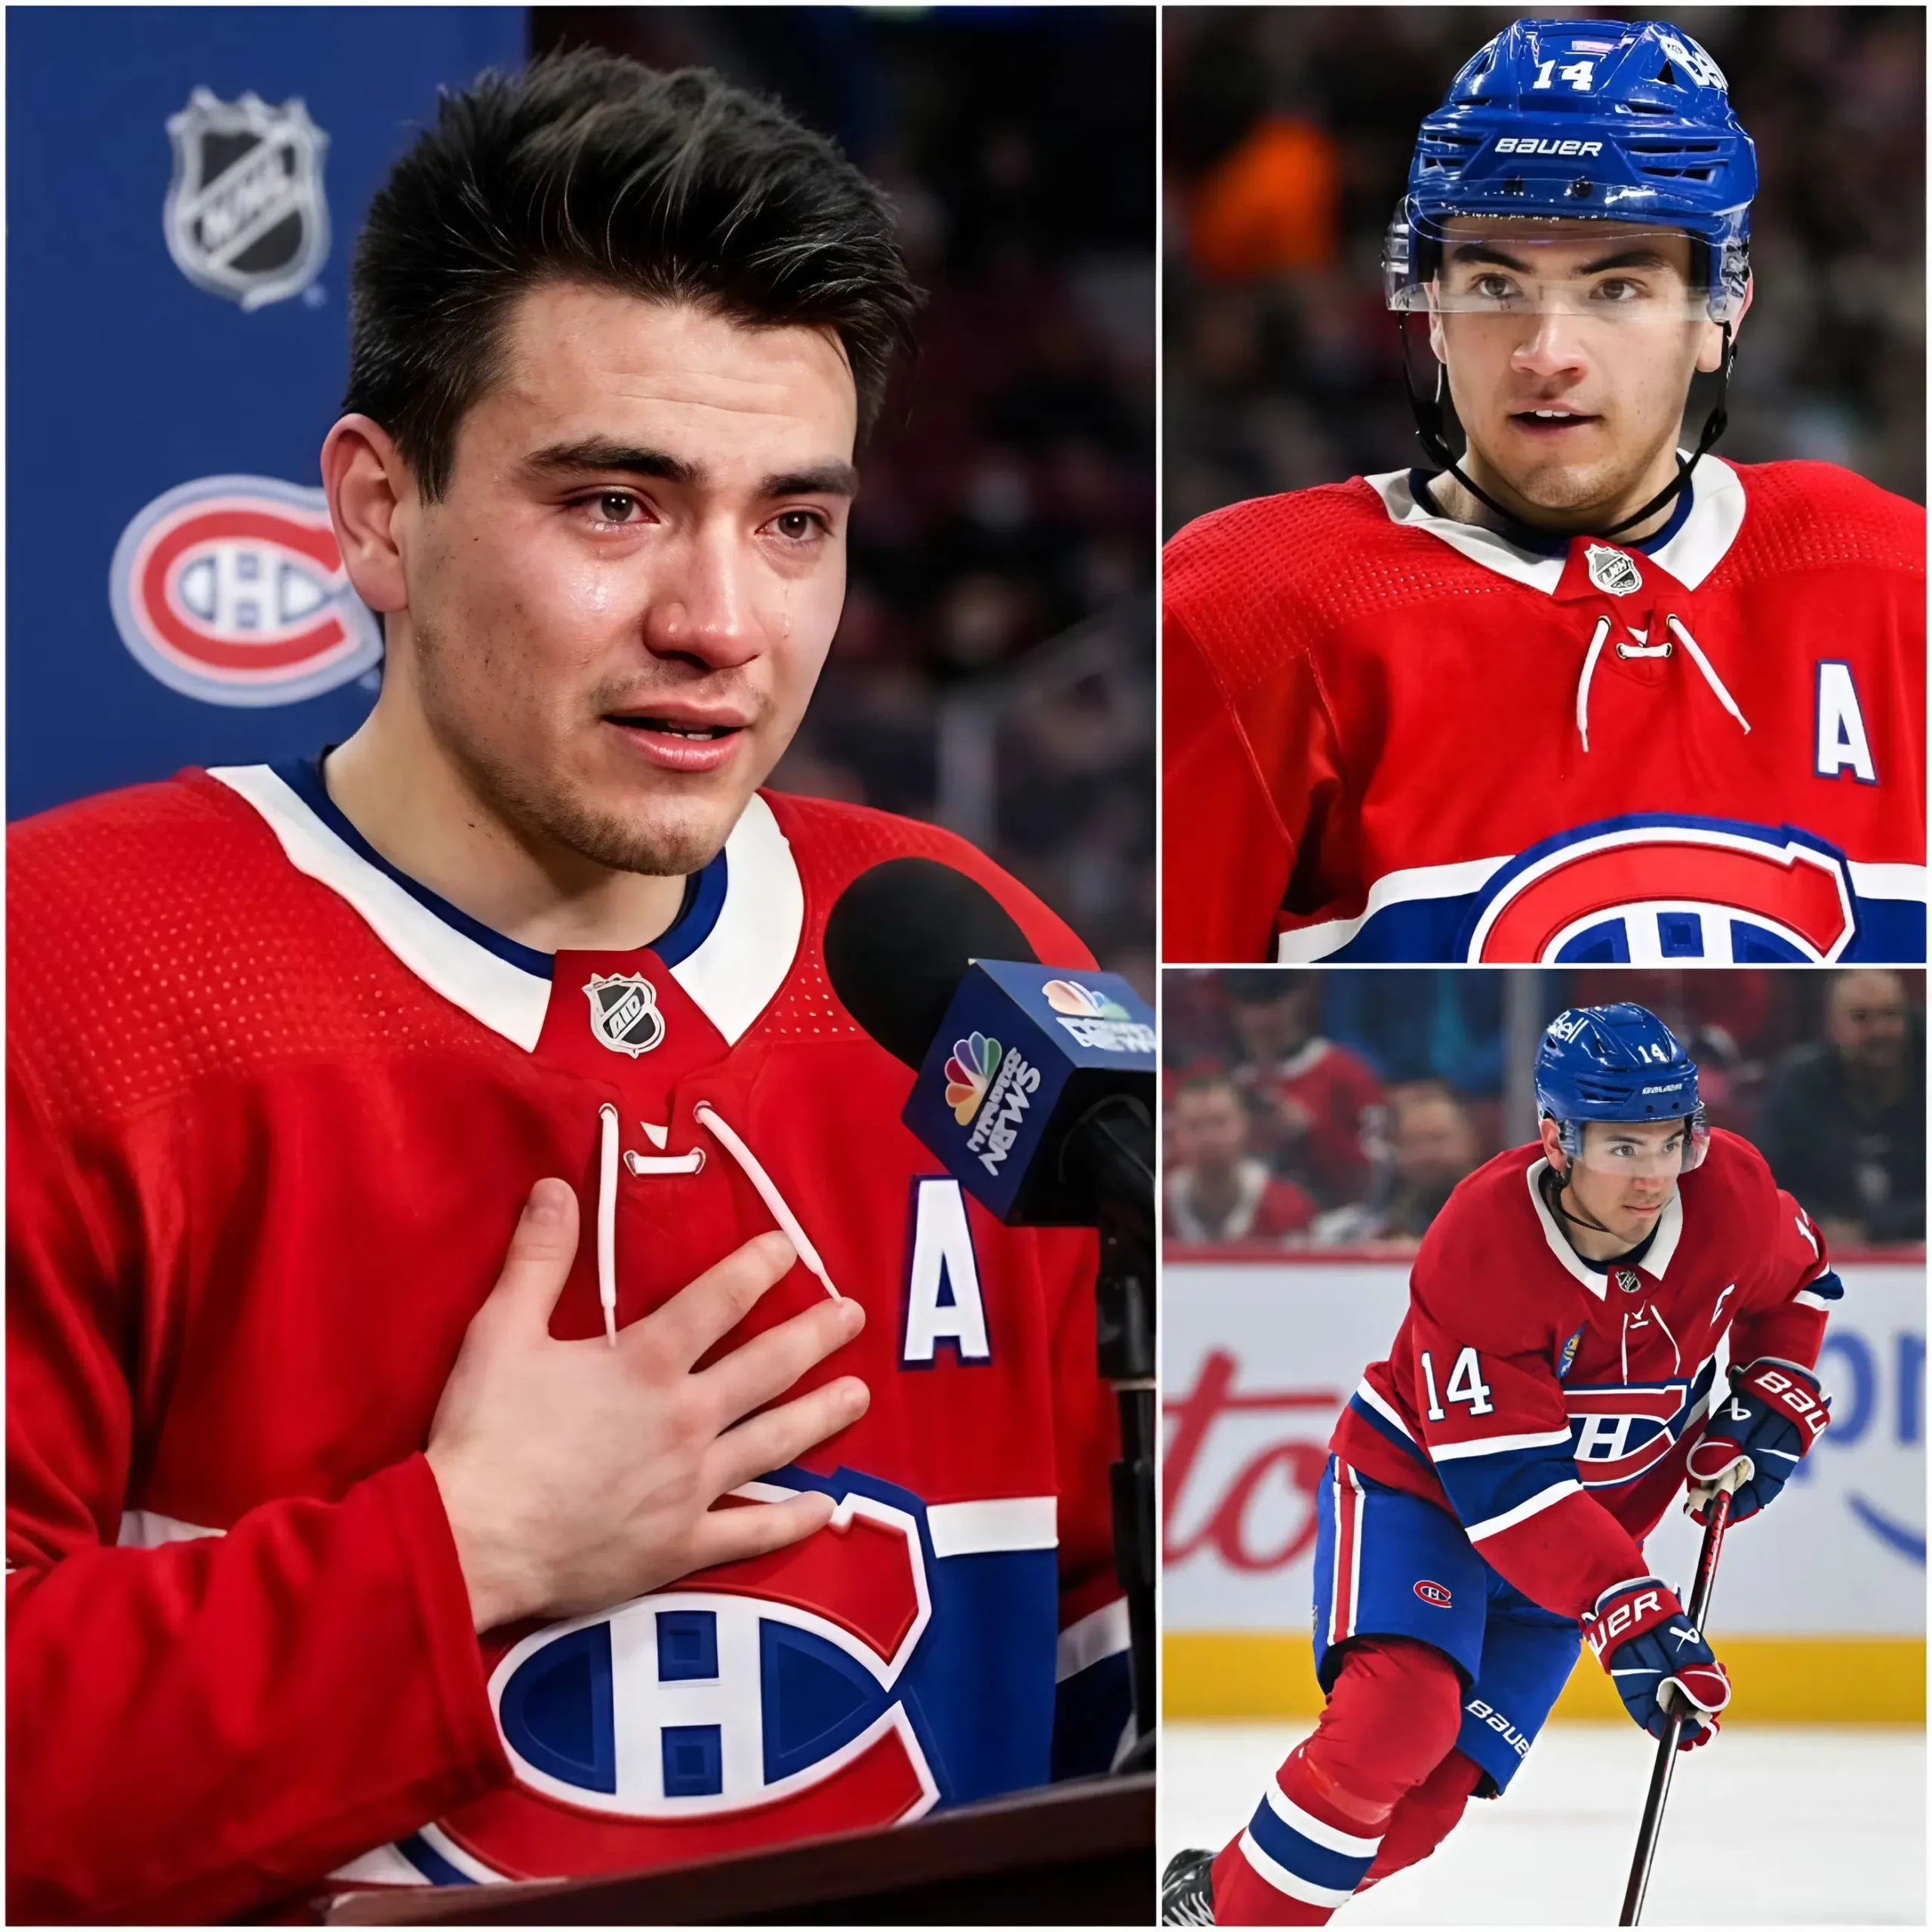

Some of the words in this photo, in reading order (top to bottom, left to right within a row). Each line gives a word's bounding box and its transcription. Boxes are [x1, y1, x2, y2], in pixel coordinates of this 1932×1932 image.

[1532, 59, 1593, 91] 14
[1815, 660, 1878, 784] A
[1638, 1043, 1669, 1063] 14
[900, 1177, 991, 1364] A
[1421, 1347, 1494, 1422] 14
